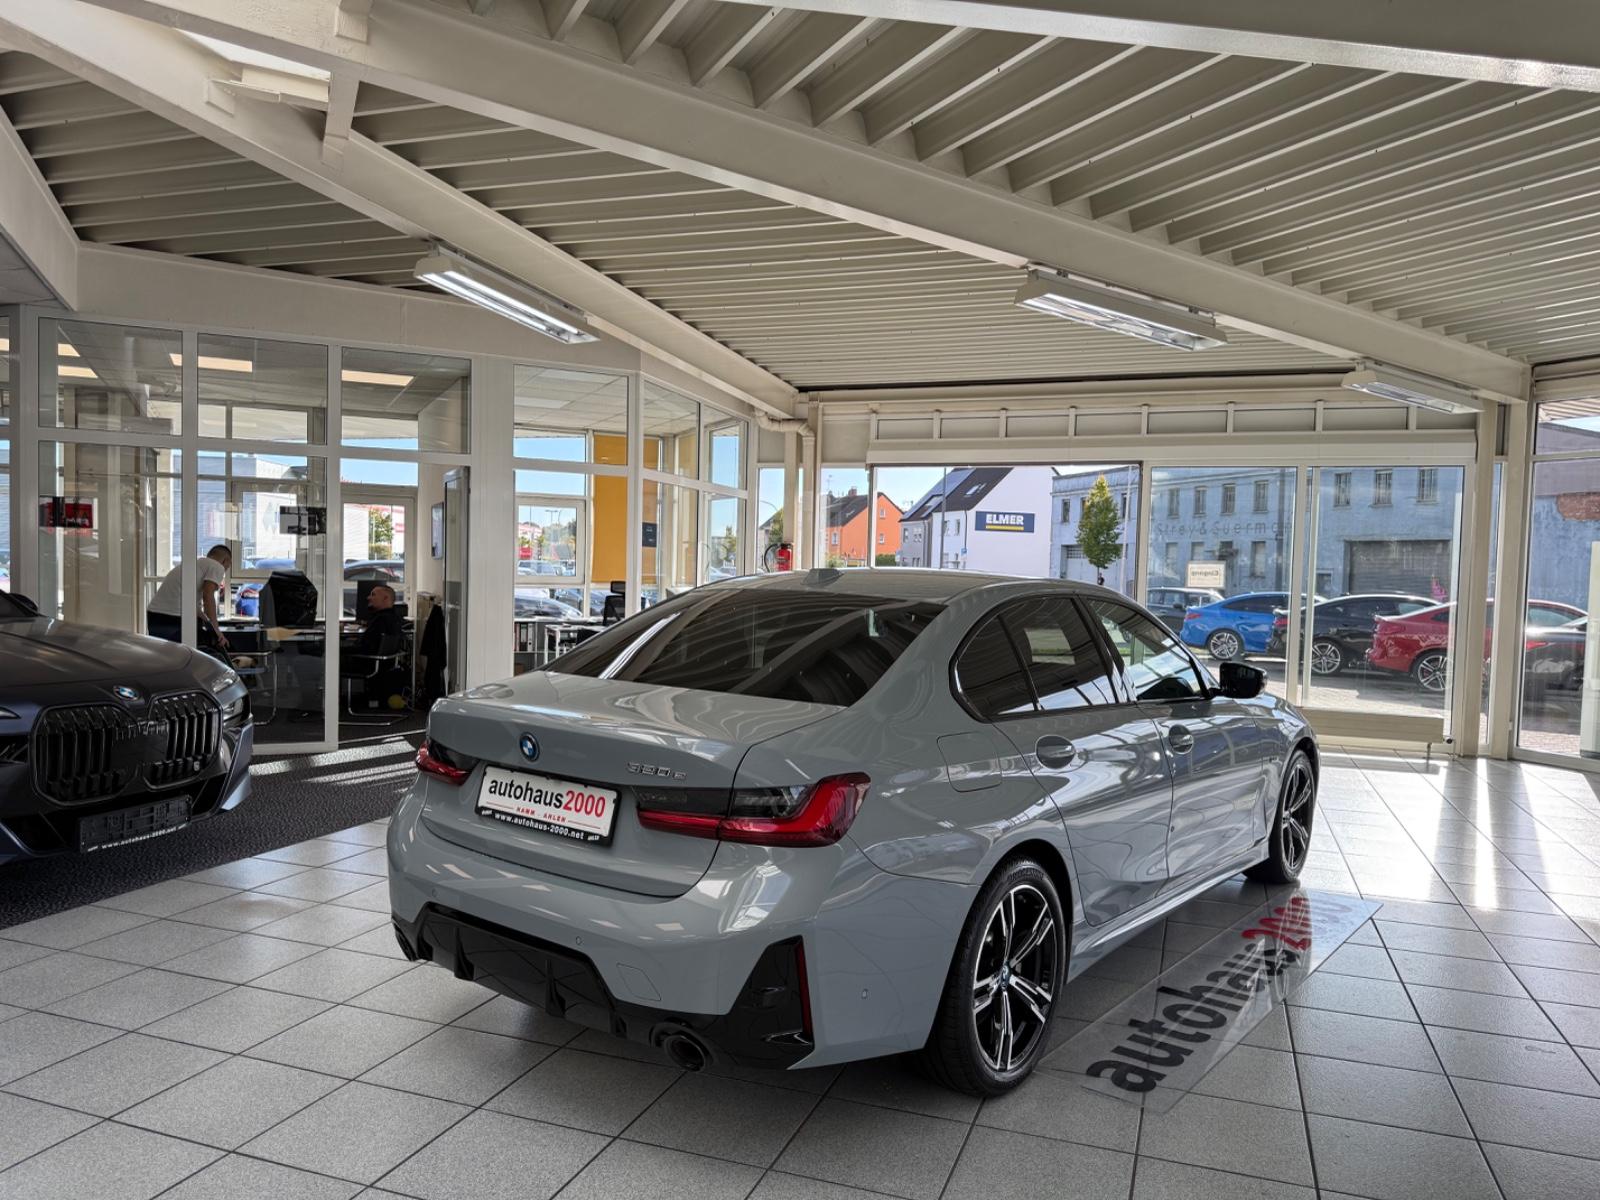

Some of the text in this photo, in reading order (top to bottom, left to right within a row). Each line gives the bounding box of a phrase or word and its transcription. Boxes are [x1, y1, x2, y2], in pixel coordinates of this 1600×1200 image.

[986, 513, 1024, 526] ELMER
[488, 779, 606, 818] autohaus2000
[495, 813, 584, 840] www.autohaus-2000.net
